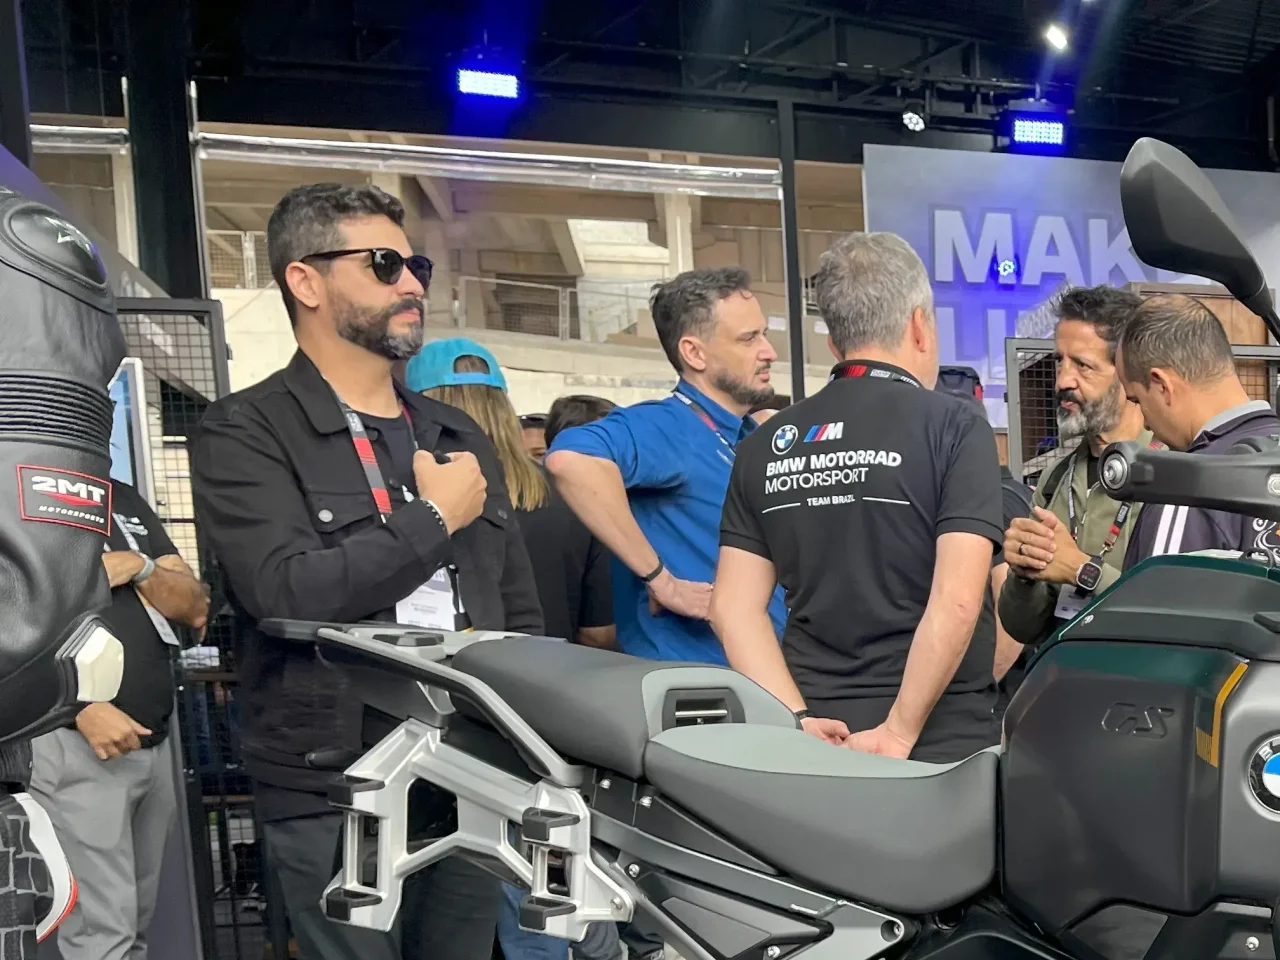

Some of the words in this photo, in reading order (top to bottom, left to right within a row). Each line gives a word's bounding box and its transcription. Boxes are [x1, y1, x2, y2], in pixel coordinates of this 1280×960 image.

[766, 456, 807, 477] BMW
[810, 449, 902, 470] MOTORRAD
[31, 475, 105, 503] 2MT
[765, 467, 869, 495] MOTORSPORT
[39, 505, 105, 524] MOTORSPORTS
[806, 496, 831, 507] TEAM
